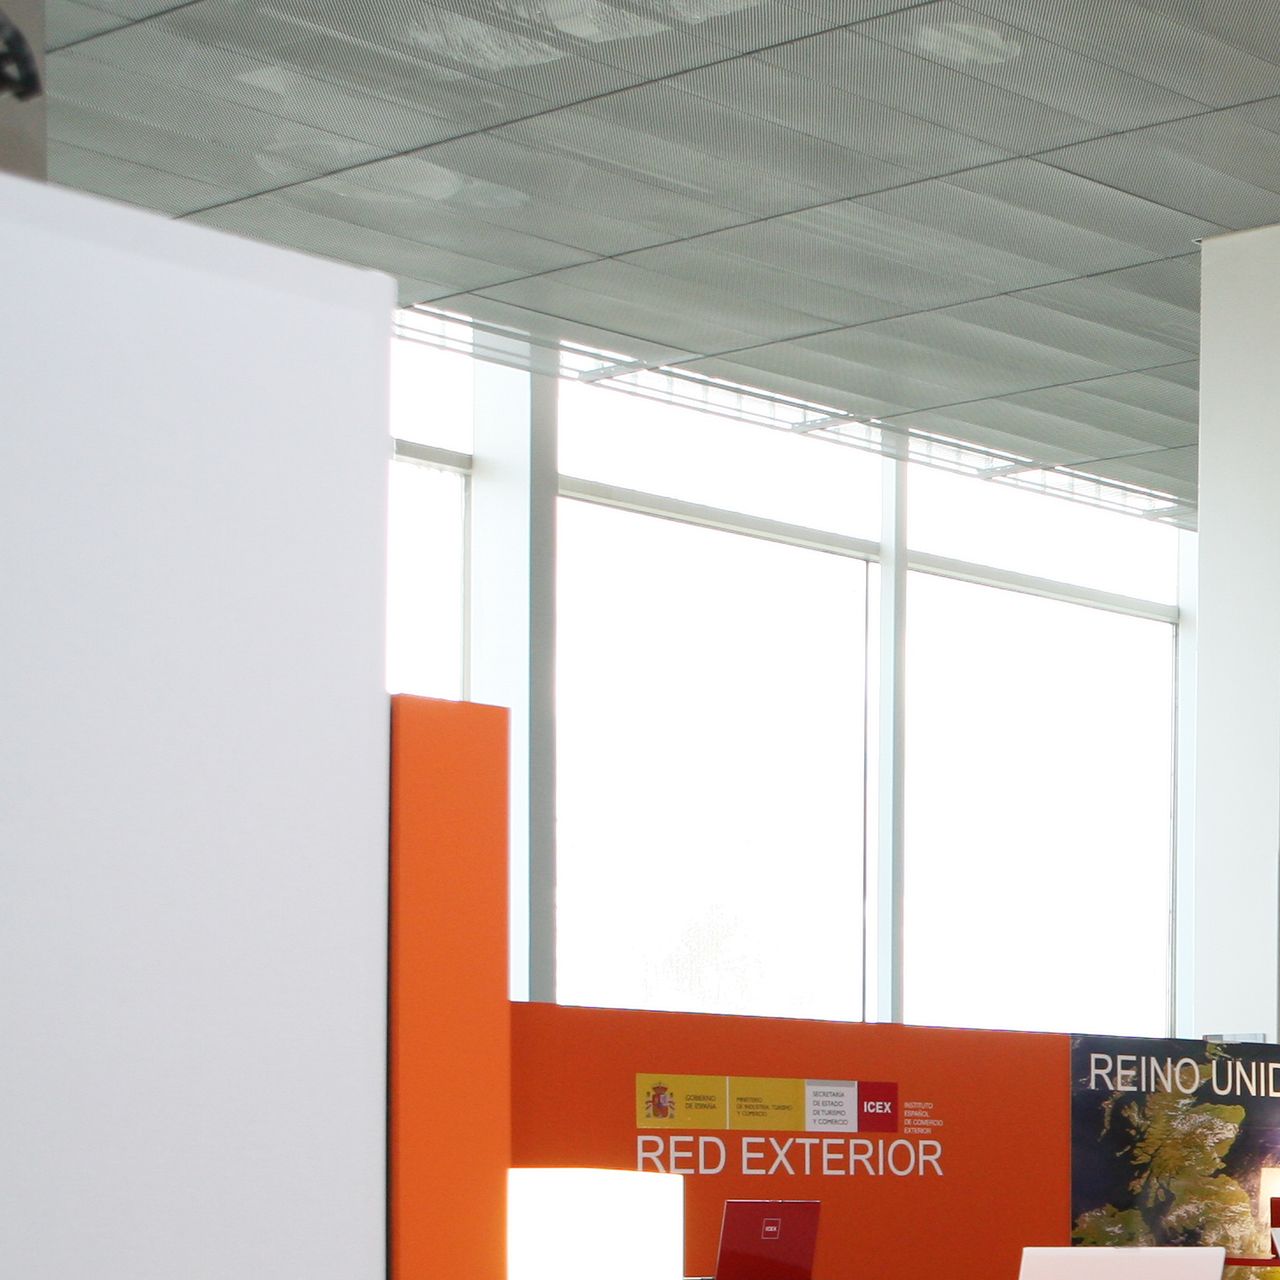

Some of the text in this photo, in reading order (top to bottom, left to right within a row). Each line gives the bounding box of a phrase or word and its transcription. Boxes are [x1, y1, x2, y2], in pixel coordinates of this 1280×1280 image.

[1089, 1053, 1200, 1094] REINO
[863, 1101, 892, 1113] ICEX
[636, 1135, 944, 1176] RED EXTERIOR
